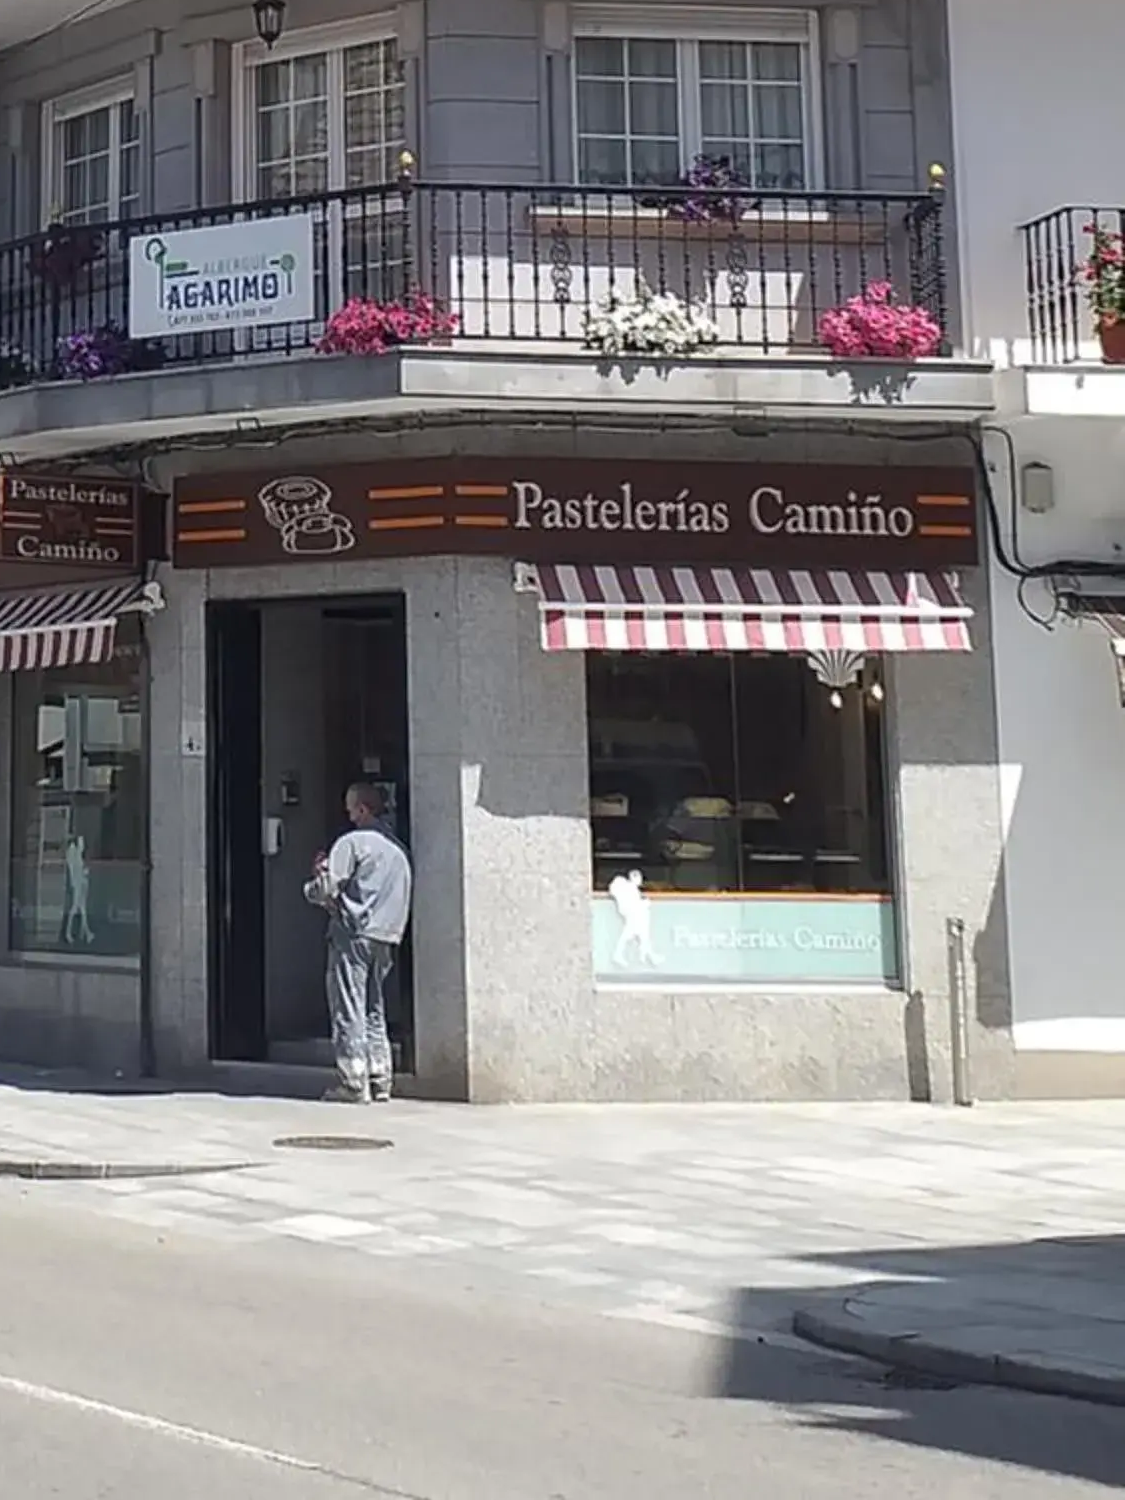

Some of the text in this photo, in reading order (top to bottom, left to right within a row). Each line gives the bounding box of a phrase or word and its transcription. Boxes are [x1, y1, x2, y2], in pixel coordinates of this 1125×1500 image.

[166, 272, 279, 311] AGARIMO
[10, 477, 129, 507] Pastelerías
[512, 481, 914, 537] Pastelerías Camiño
[15, 534, 120, 563] Camiño
